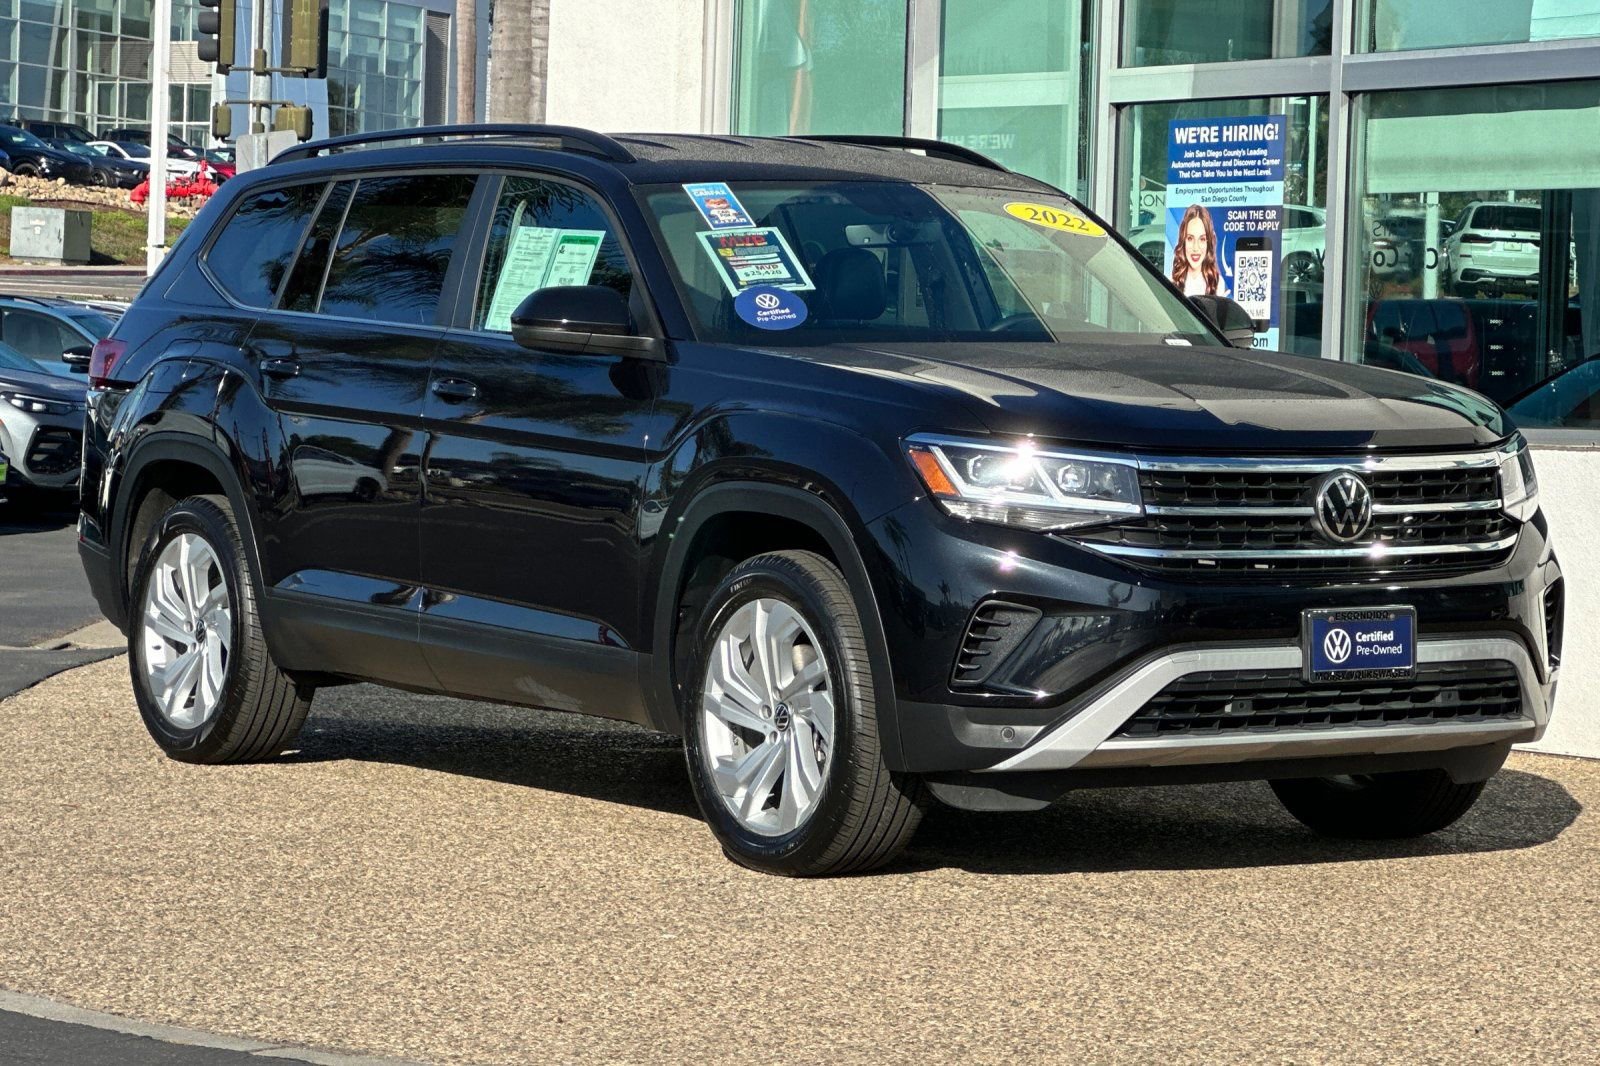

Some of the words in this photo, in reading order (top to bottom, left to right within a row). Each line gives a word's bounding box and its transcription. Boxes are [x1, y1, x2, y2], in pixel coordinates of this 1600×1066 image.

[1174, 126, 1219, 144] WE'RE
[1222, 124, 1279, 142] HIRING!
[1206, 150, 1222, 158] Diego
[1223, 149, 1246, 158] County's
[1246, 148, 1268, 157] Leading
[1171, 160, 1200, 168] Automotive
[1202, 160, 1221, 168] Retailer
[1208, 186, 1243, 194] Opportunities
[1245, 185, 1274, 193] Throughout
[1212, 195, 1227, 204] Diego
[1024, 208, 1089, 231] 2022
[1228, 210, 1247, 220] SCAN
[1249, 210, 1264, 219] THE
[1265, 210, 1277, 219] QR
[1224, 222, 1244, 231] CODE
[1246, 222, 1256, 231] TO
[1257, 221, 1280, 230] APPLY
[757, 308, 790, 316] Certified
[756, 313, 796, 322] Pre-Owned
[1335, 611, 1389, 620] ESCONDIDO
[1356, 631, 1394, 642] Certified
[1356, 644, 1402, 655] Pre-Owned
